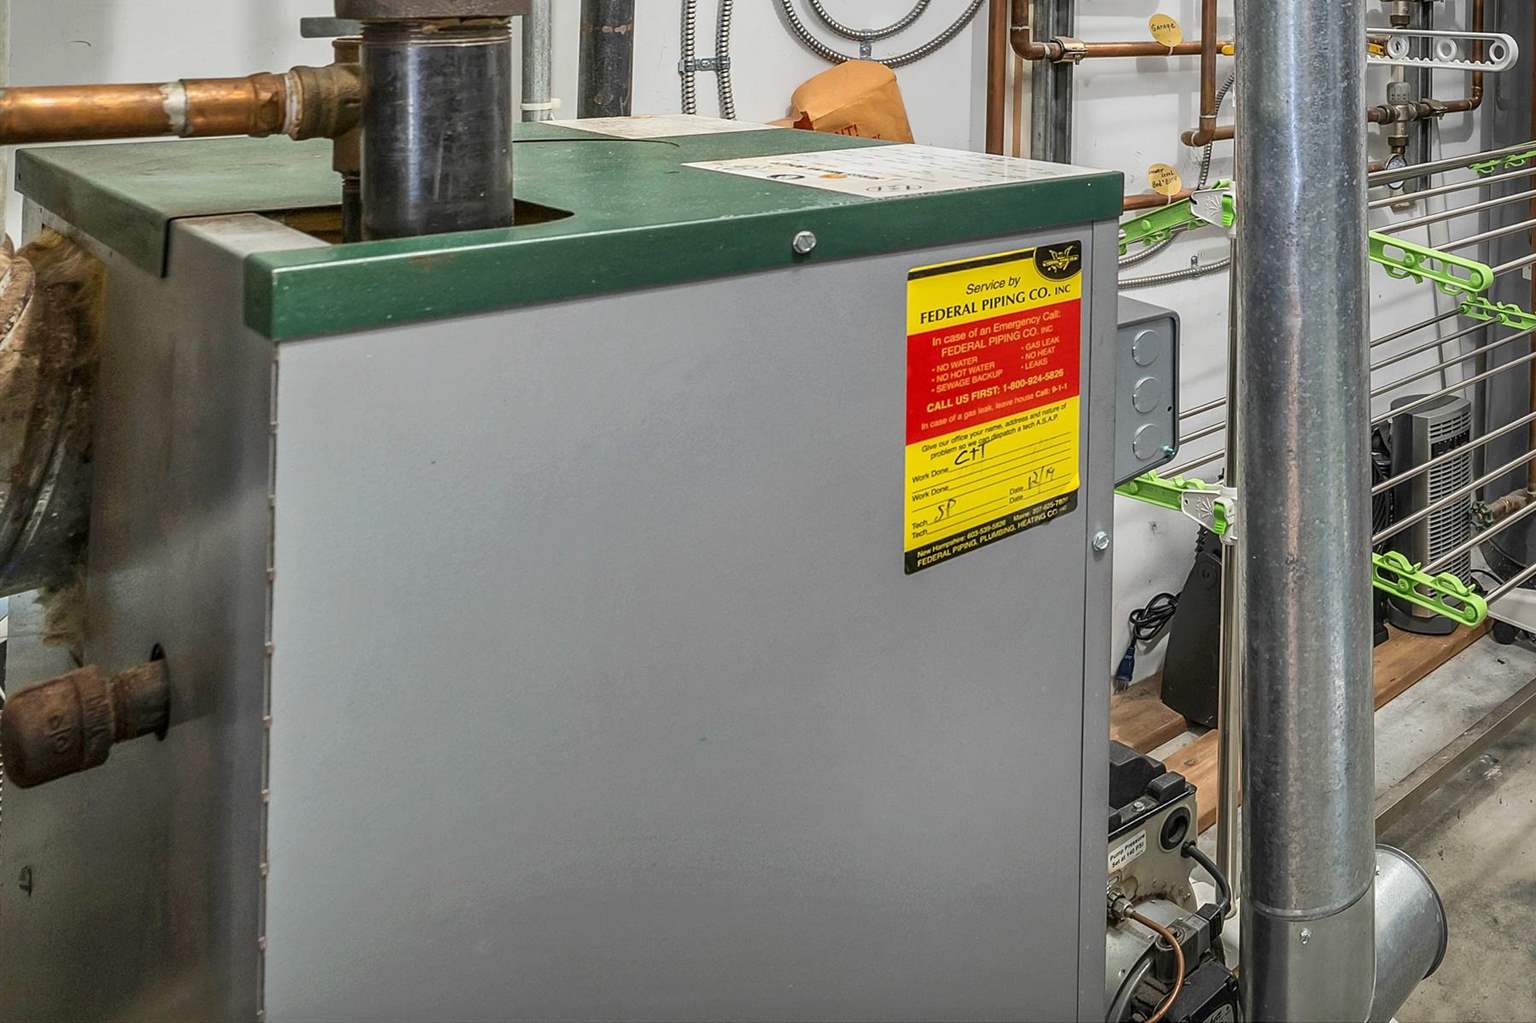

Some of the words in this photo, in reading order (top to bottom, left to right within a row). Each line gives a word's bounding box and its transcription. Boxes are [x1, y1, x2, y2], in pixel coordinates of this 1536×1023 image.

[966, 279, 1005, 296] Service
[1008, 276, 1021, 288] by
[920, 302, 978, 324] FEDERAL
[981, 291, 1025, 311] PIPING
[1029, 286, 1051, 300] CO.
[1054, 284, 1071, 295] INC
[932, 336, 942, 347] In
[943, 331, 966, 344] case
[968, 327, 978, 338] of
[979, 325, 991, 336] an
[993, 314, 1041, 334] Emergency
[1042, 309, 1062, 321] Call:
[941, 340, 986, 358] FEDERAL
[988, 330, 1021, 347] PIPING
[1040, 325, 1054, 335] INC
[1025, 340, 1041, 351] GAS
[1041, 336, 1060, 348] LEAK
[1025, 351, 1037, 361] NO
[1037, 346, 1056, 358] HEAT
[936, 362, 950, 373] NO
[950, 356, 978, 370] WATER
[936, 372, 949, 383] NO
[950, 368, 967, 380] HOT
[969, 361, 996, 375] WATER
[1024, 358, 1048, 370] LEAKS
[936, 379, 972, 393] SEWAGE
[972, 369, 1003, 383] BACKUP
[926, 398, 953, 413] CALL
[955, 393, 969, 405] US
[971, 385, 1001, 402] FIRST:
[930, 417, 948, 429] case
[963, 409, 977, 420] gas
[995, 399, 1014, 410] leave
[1014, 394, 1034, 406] house
[1051, 383, 1068, 394] 9-1-1
[921, 441, 937, 453] Give
[938, 437, 950, 448] our
[950, 431, 970, 445] office
[969, 428, 984, 441] your
[1005, 415, 1029, 428] address
[1029, 411, 1042, 421] and
[1042, 406, 1061, 418] nature
[930, 446, 958, 461] problem
[912, 472, 930, 483] Work
[931, 466, 950, 477] Done
[912, 491, 930, 502] Work
[931, 485, 950, 496] Done
[1009, 484, 1025, 496] Date
[1009, 494, 1025, 505] Date
[912, 519, 928, 530] Tech
[912, 529, 928, 540] Tech
[917, 551, 952, 568] FEDERAL
[1018, 513, 1047, 529] HEATING
[917, 549, 931, 559] New
[1125, 833, 1145, 851] Pressure
